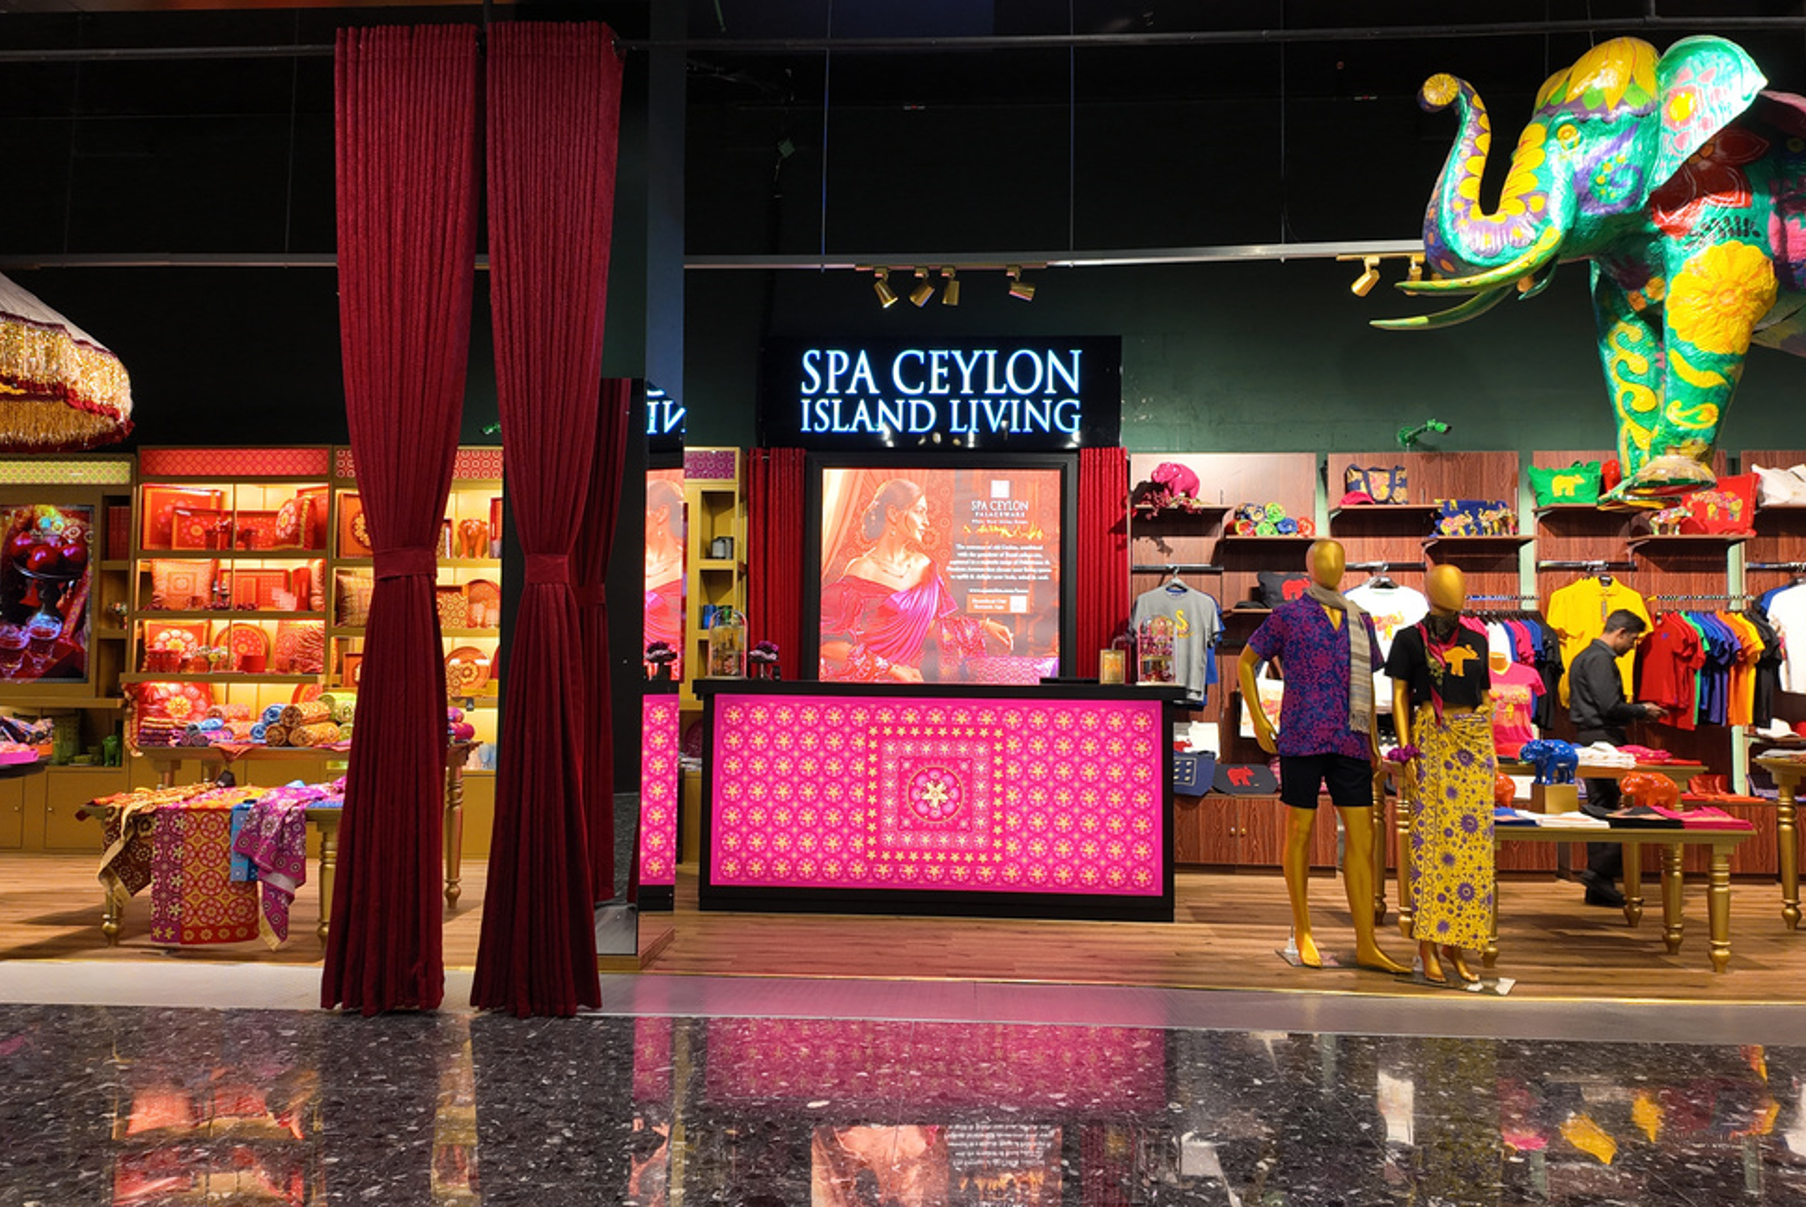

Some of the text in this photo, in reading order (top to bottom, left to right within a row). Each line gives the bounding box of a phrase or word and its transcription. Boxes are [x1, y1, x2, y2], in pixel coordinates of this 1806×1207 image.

[801, 349, 1082, 394] SPA CEYLON
[801, 399, 1081, 434] ISLAND LIVING
[971, 501, 1029, 511] SPA CEYLON
